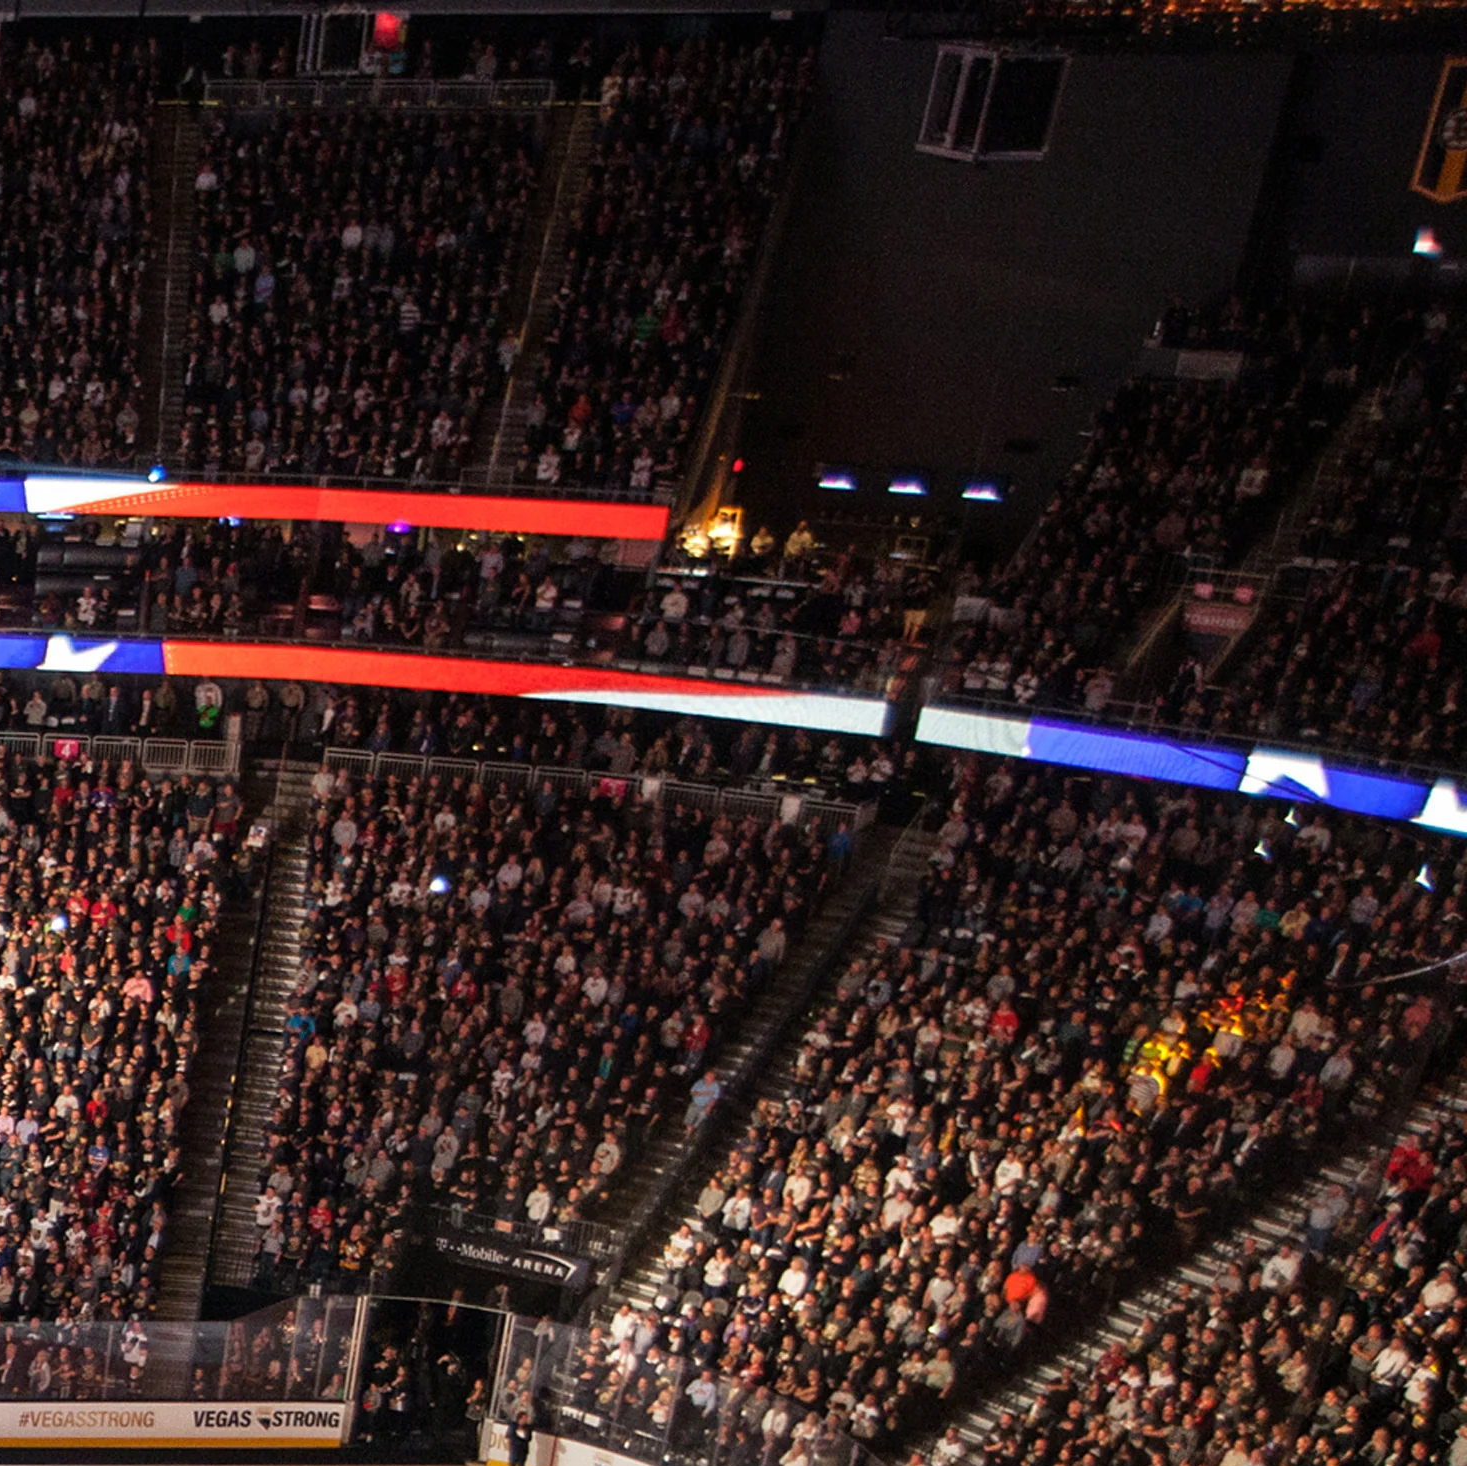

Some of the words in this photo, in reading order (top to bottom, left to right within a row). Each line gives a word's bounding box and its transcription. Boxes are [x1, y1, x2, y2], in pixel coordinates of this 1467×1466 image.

[513, 1258, 564, 1277] ARENA
[19, 1410, 155, 1429] #VEGASSTRONG
[193, 1410, 252, 1428] VEGAS
[272, 1410, 340, 1429] STRONG
